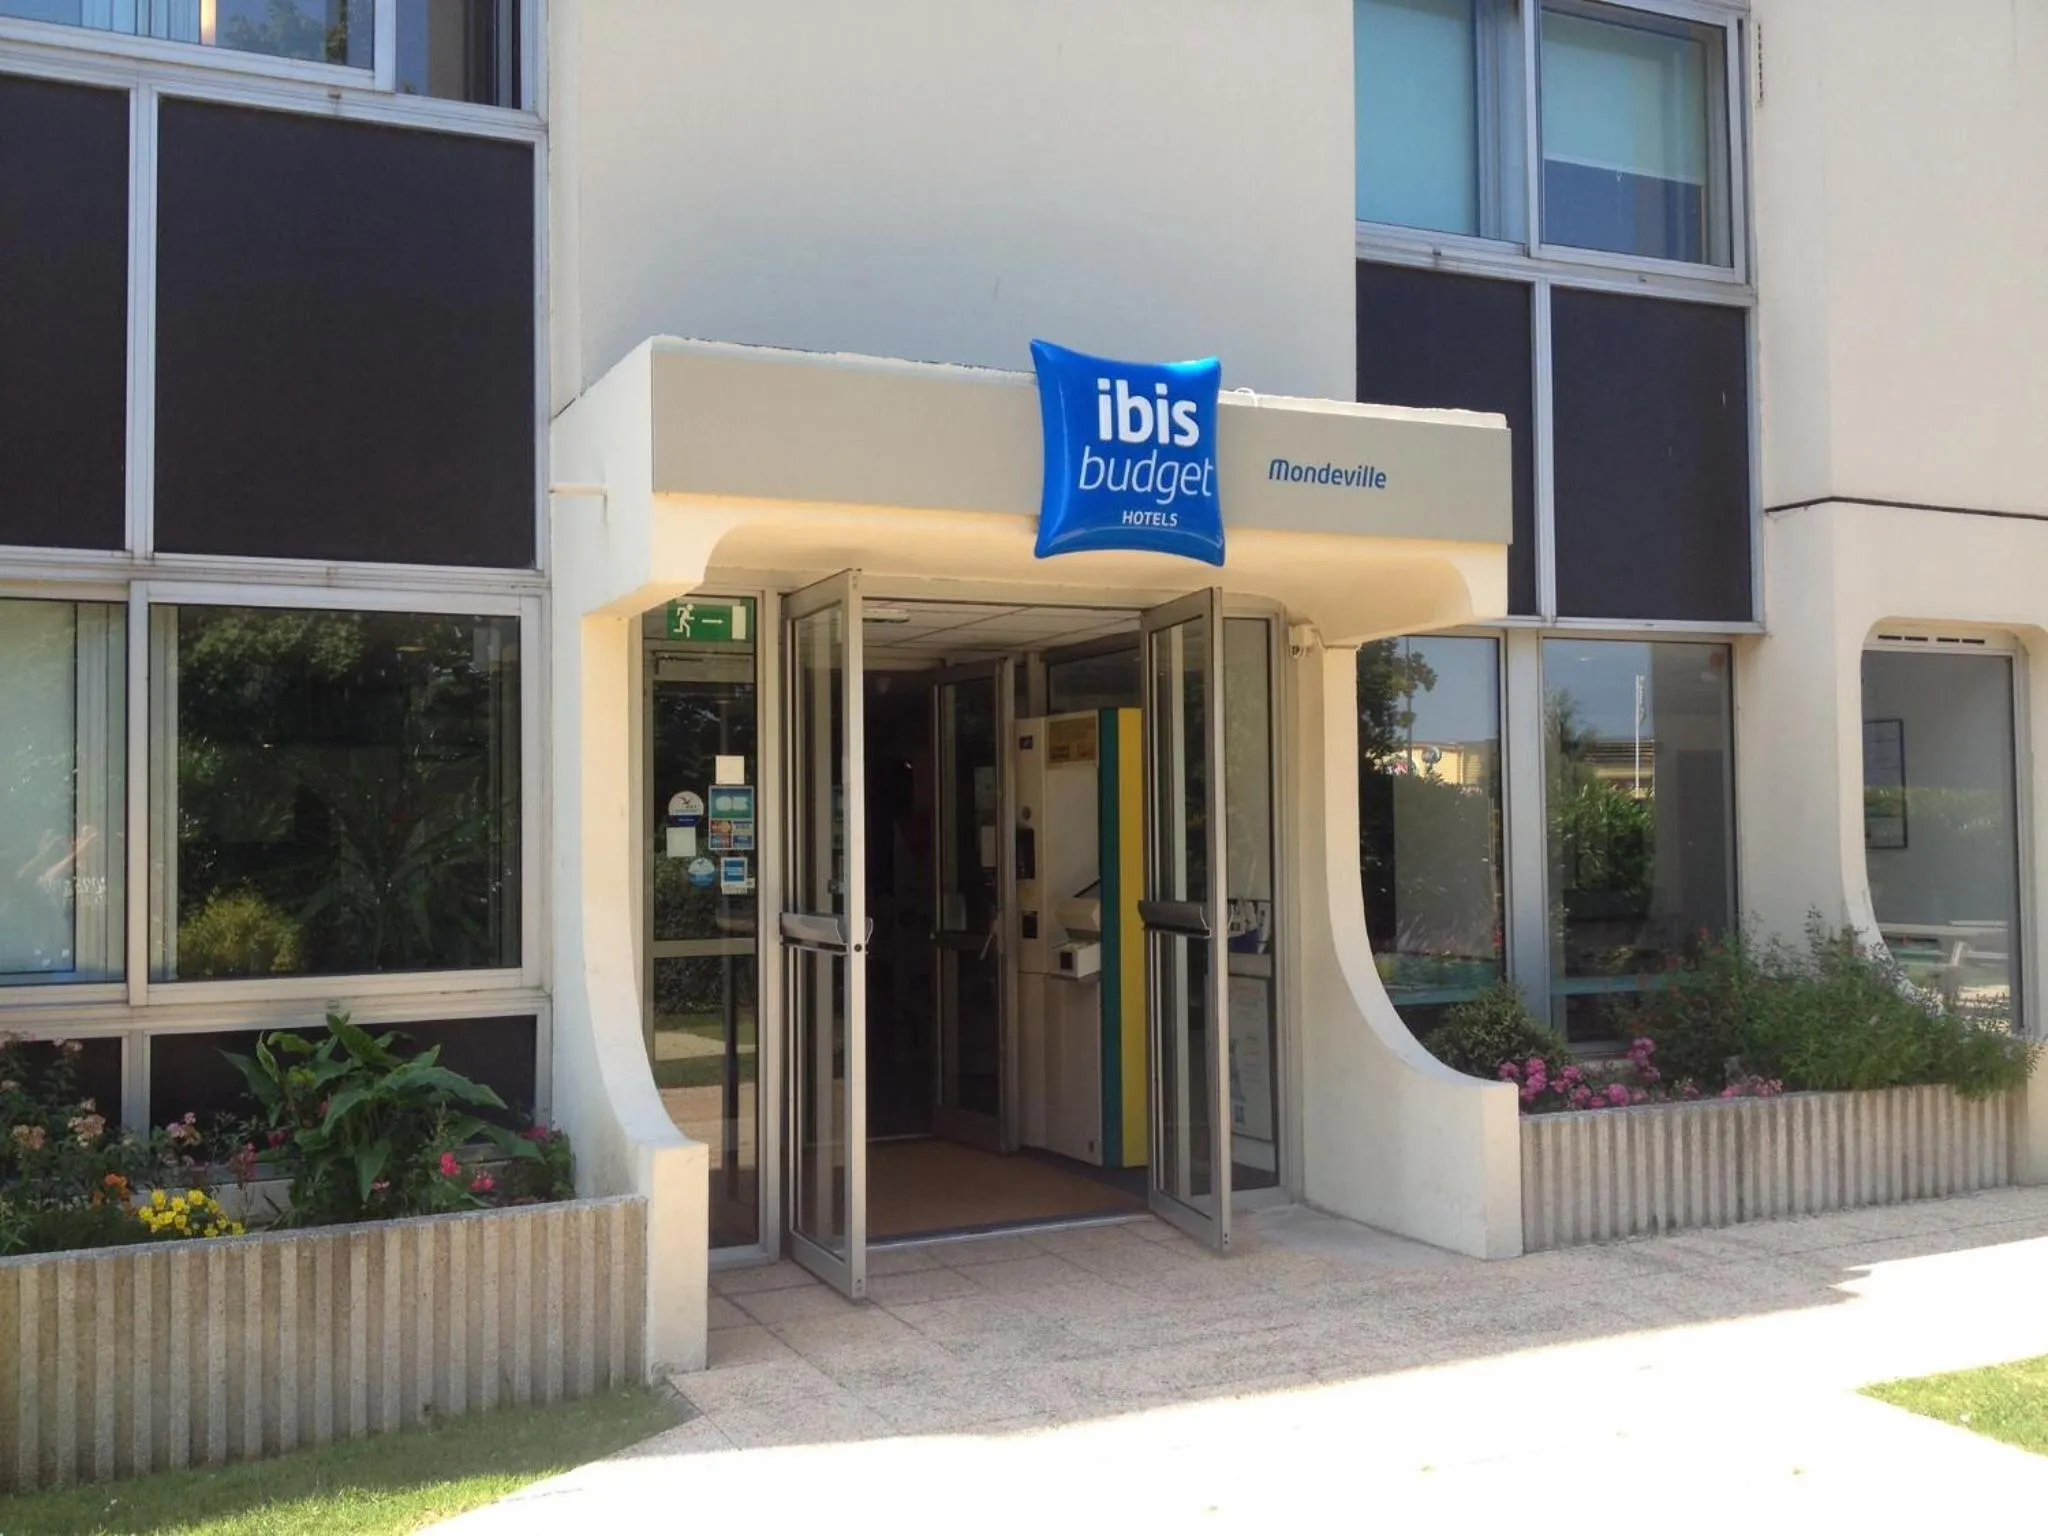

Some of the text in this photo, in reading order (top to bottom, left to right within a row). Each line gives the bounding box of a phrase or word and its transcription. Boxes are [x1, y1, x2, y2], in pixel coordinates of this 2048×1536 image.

[1098, 378, 1200, 447] ibis
[1079, 445, 1214, 505] budget
[1268, 458, 1387, 489] Mondeville
[1122, 510, 1178, 527] HOTELS
